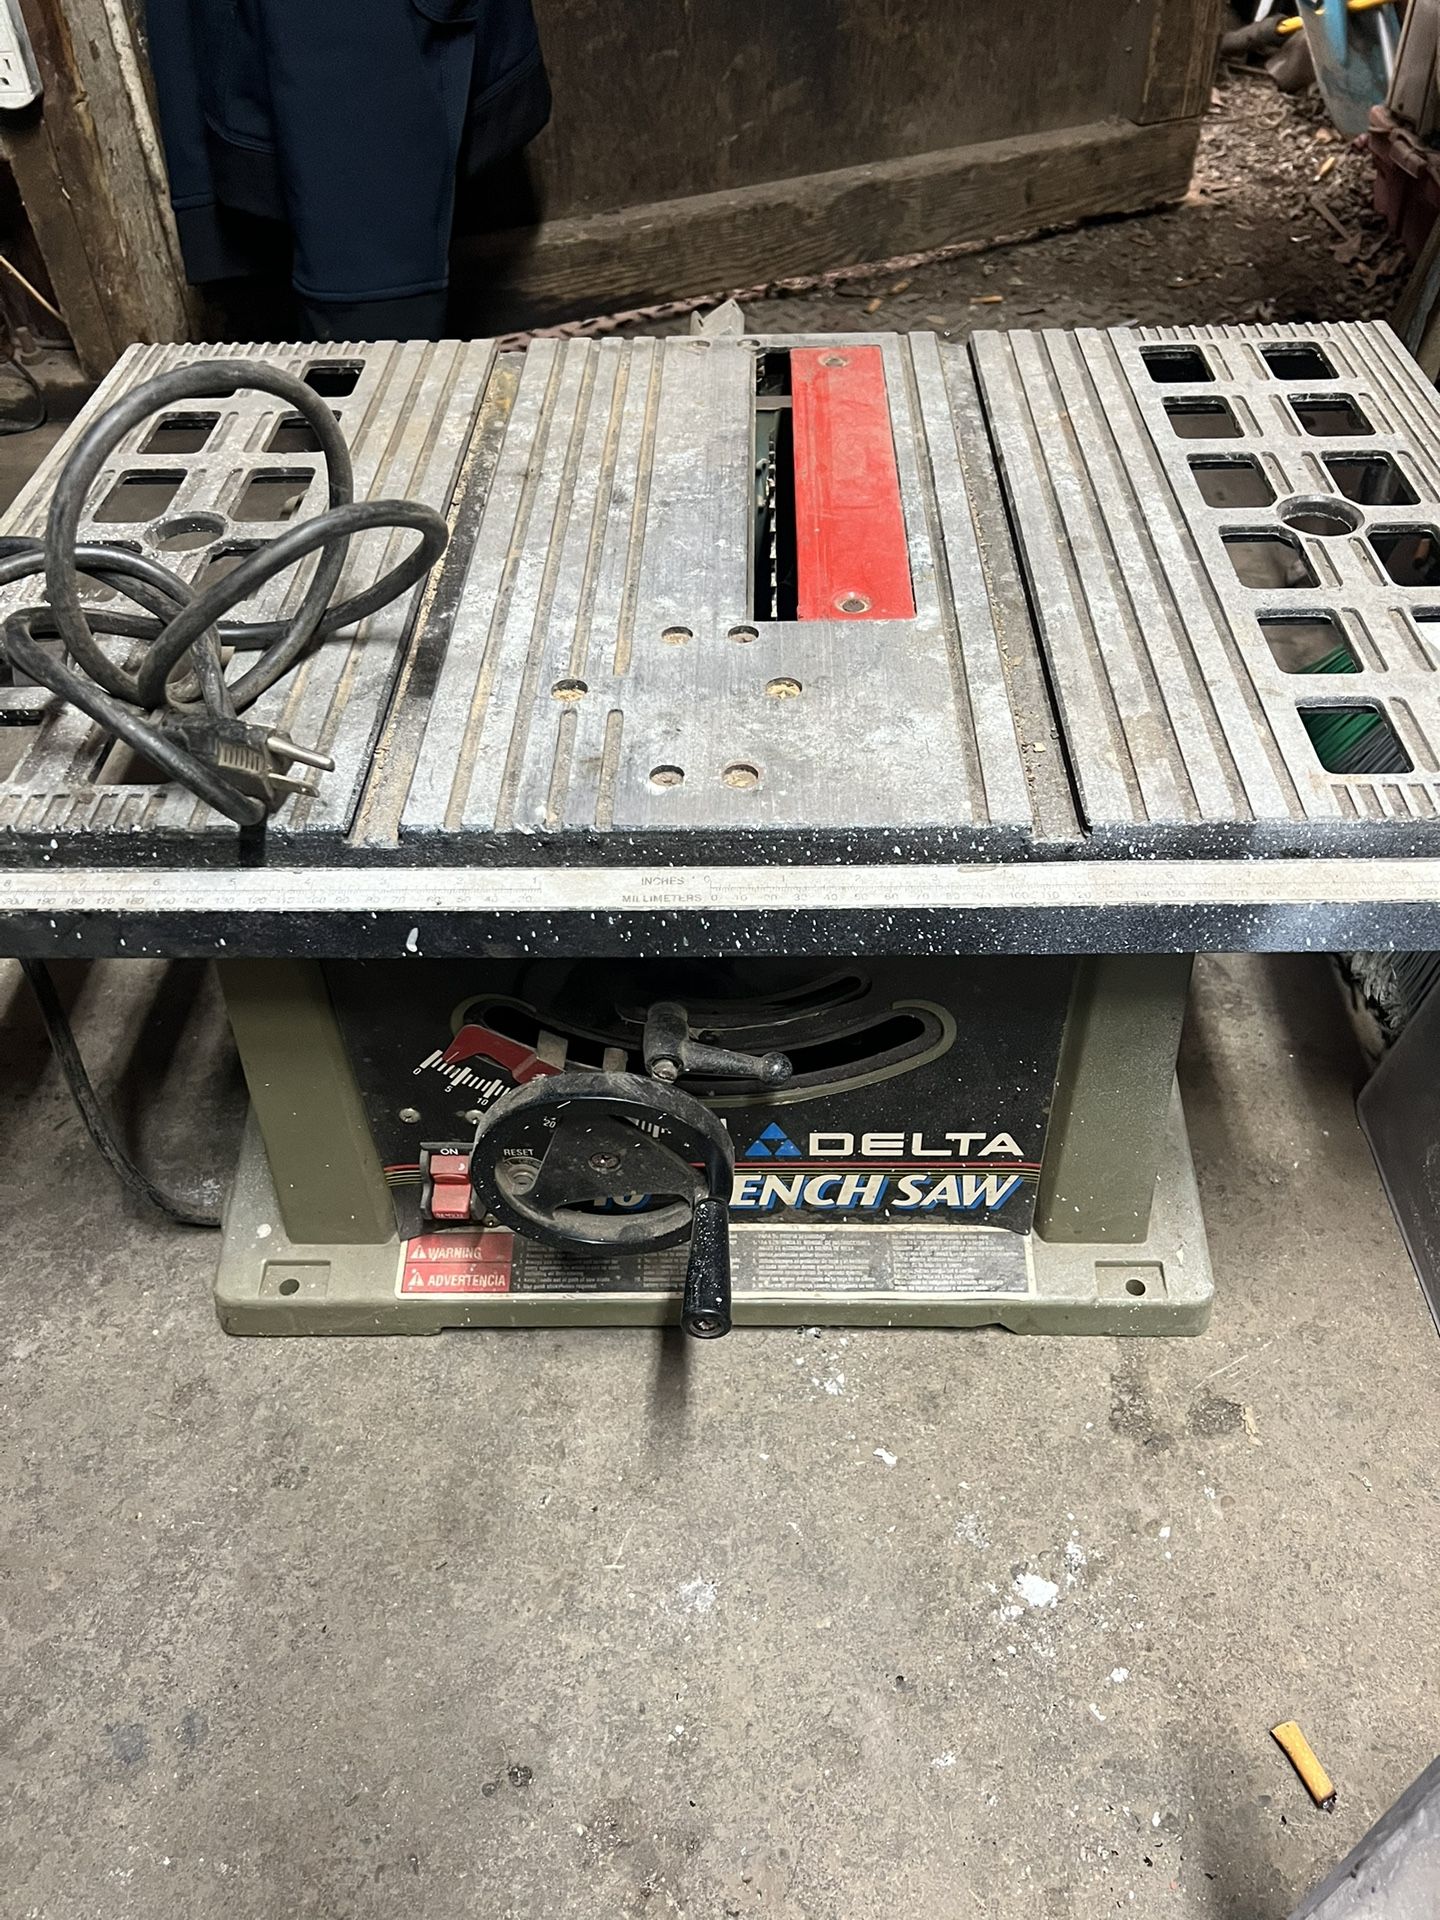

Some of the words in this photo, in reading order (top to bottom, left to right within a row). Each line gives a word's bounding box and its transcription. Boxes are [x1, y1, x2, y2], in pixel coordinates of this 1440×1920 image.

[152, 878, 160, 886] 6
[641, 876, 685, 886] INCHES
[622, 894, 702, 903] MILLIMETERS
[412, 1067, 422, 1076] 0
[444, 1085, 453, 1093] 5
[476, 1097, 489, 1106] 10
[543, 1119, 557, 1129] 20
[809, 1132, 1024, 1157] DELTA
[440, 1148, 459, 1156] ON
[503, 1148, 534, 1157] RESET
[728, 1174, 889, 1210] ENCH
[891, 1174, 1024, 1210] SAW
[428, 1247, 482, 1261] WARNING
[427, 1274, 506, 1287] ADVERTENCIA
